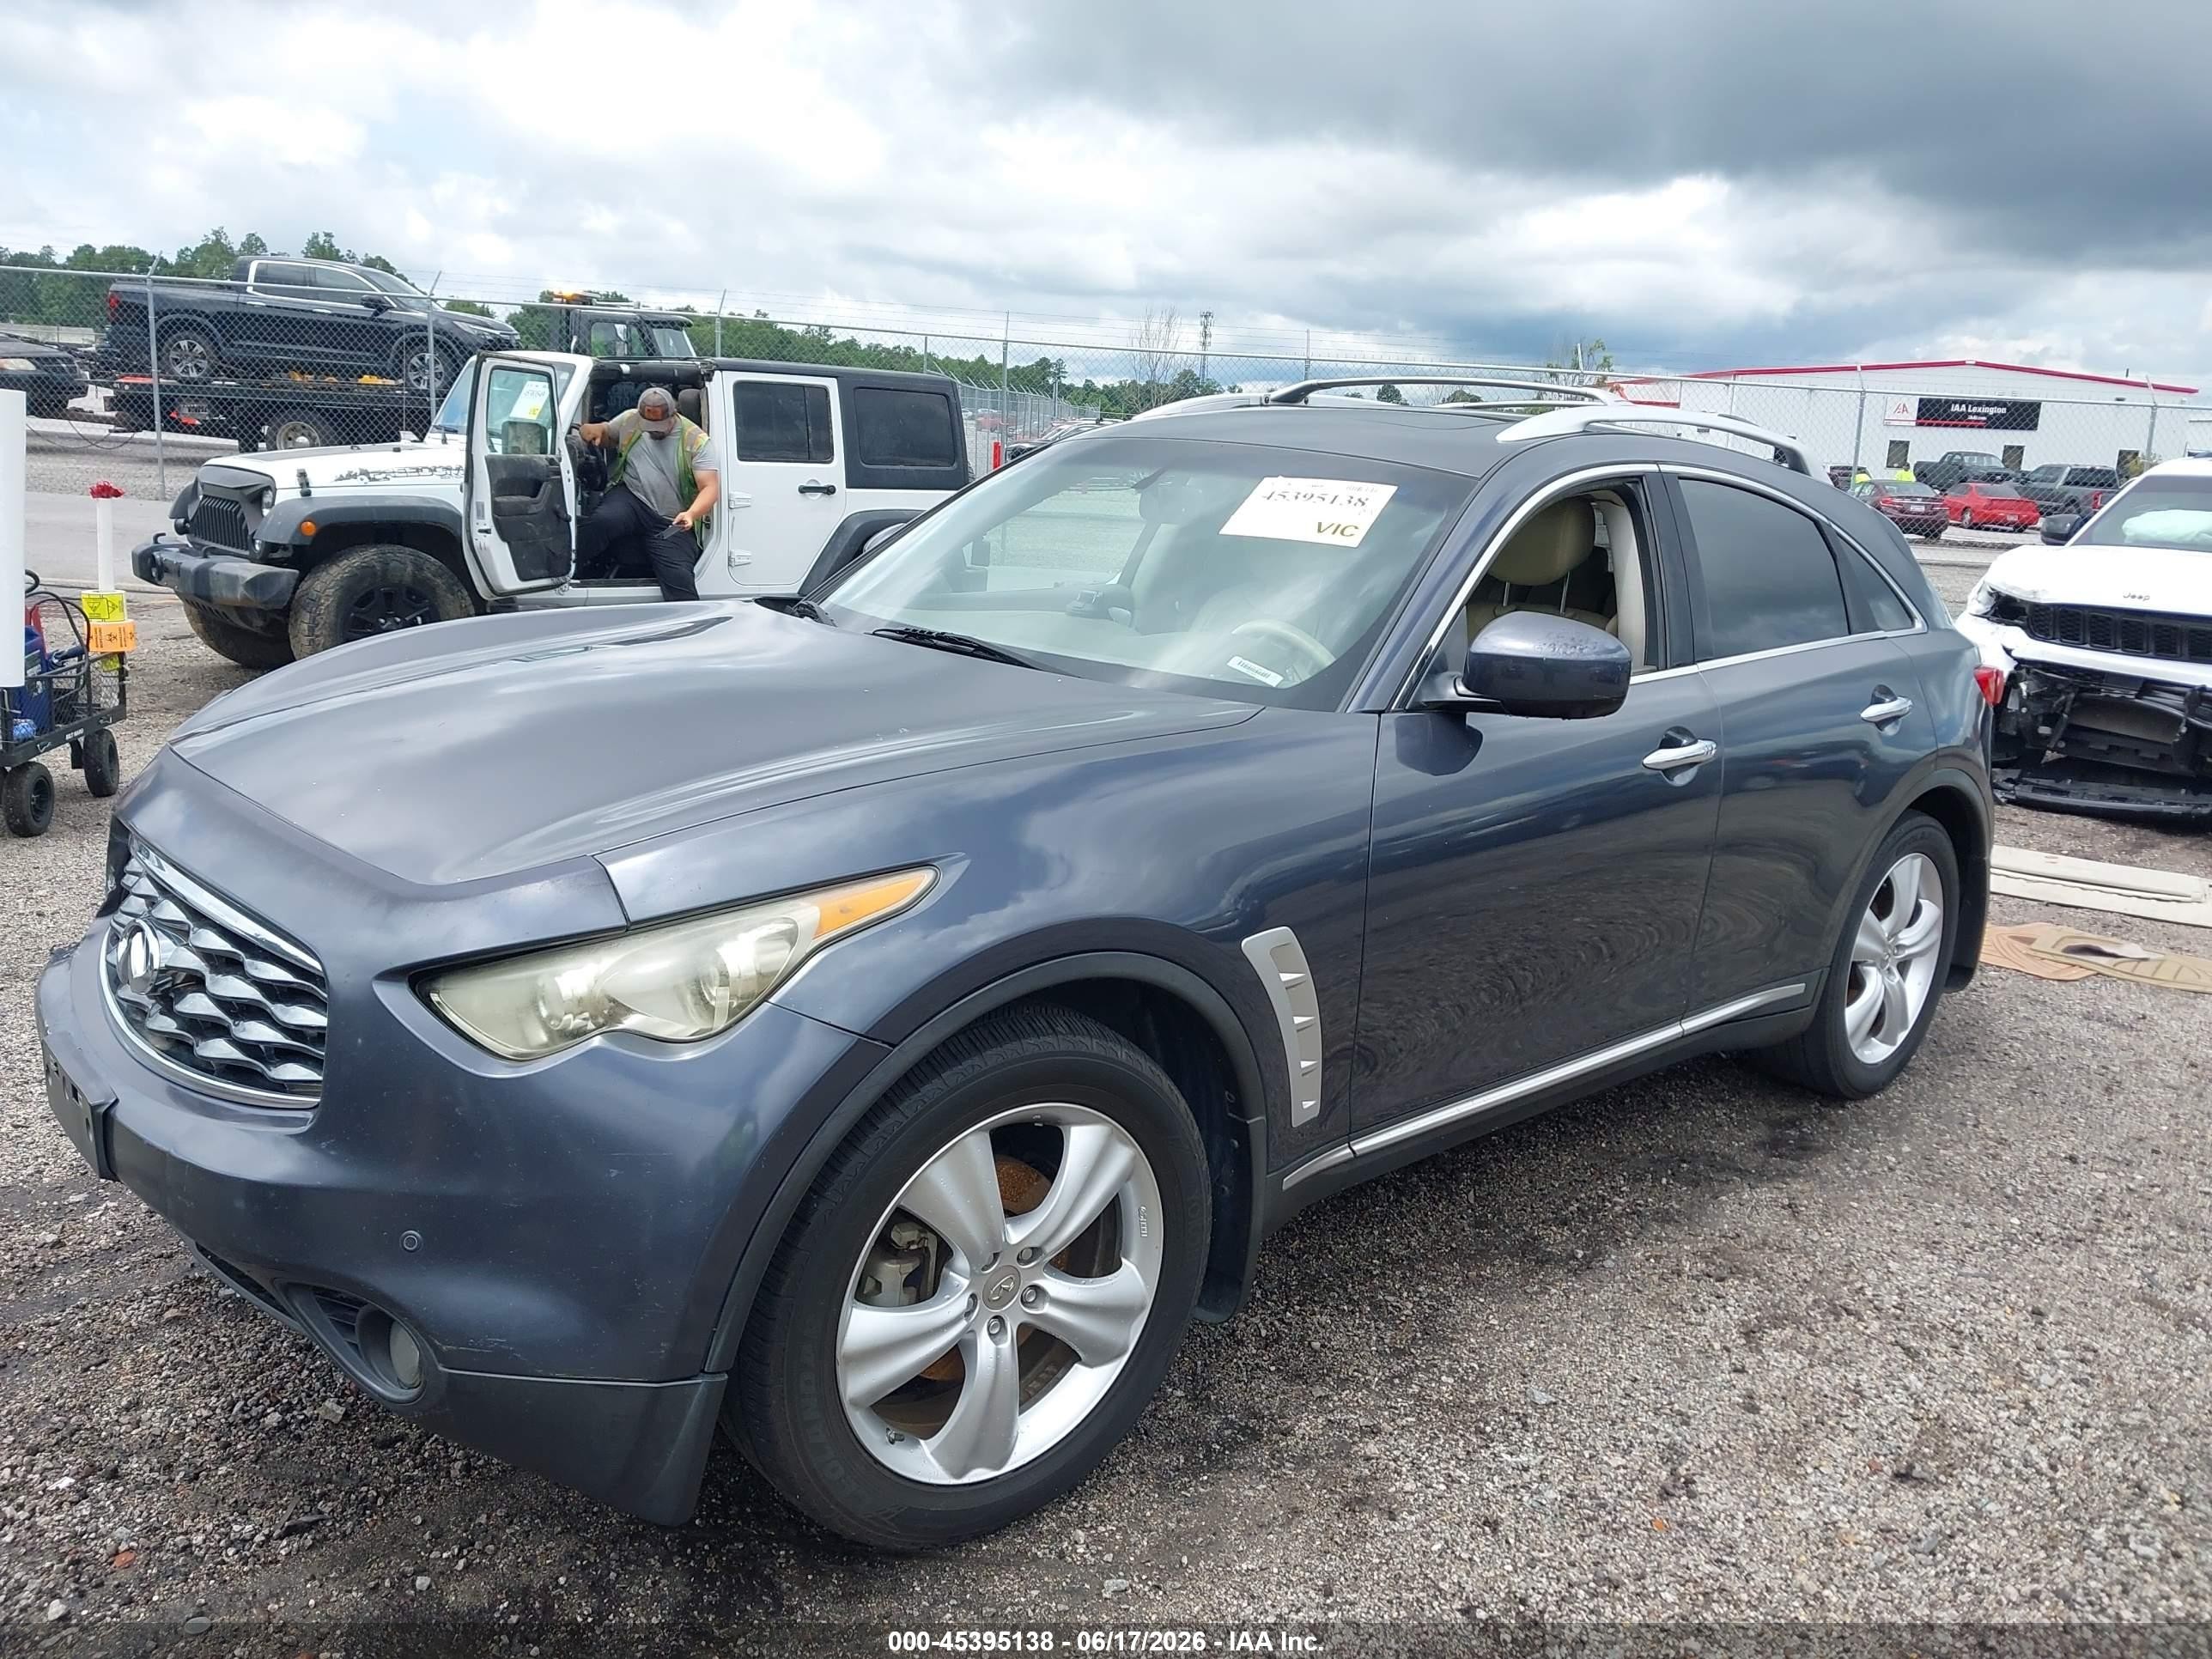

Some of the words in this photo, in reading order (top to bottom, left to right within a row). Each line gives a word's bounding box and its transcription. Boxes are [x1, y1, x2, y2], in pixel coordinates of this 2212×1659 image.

[1951, 404, 1966, 412] IAA
[1967, 404, 2007, 415] Lexington
[1261, 490, 1370, 507] 45395138
[1316, 521, 1360, 538] VIC
[2122, 592, 2151, 602] Jeep
